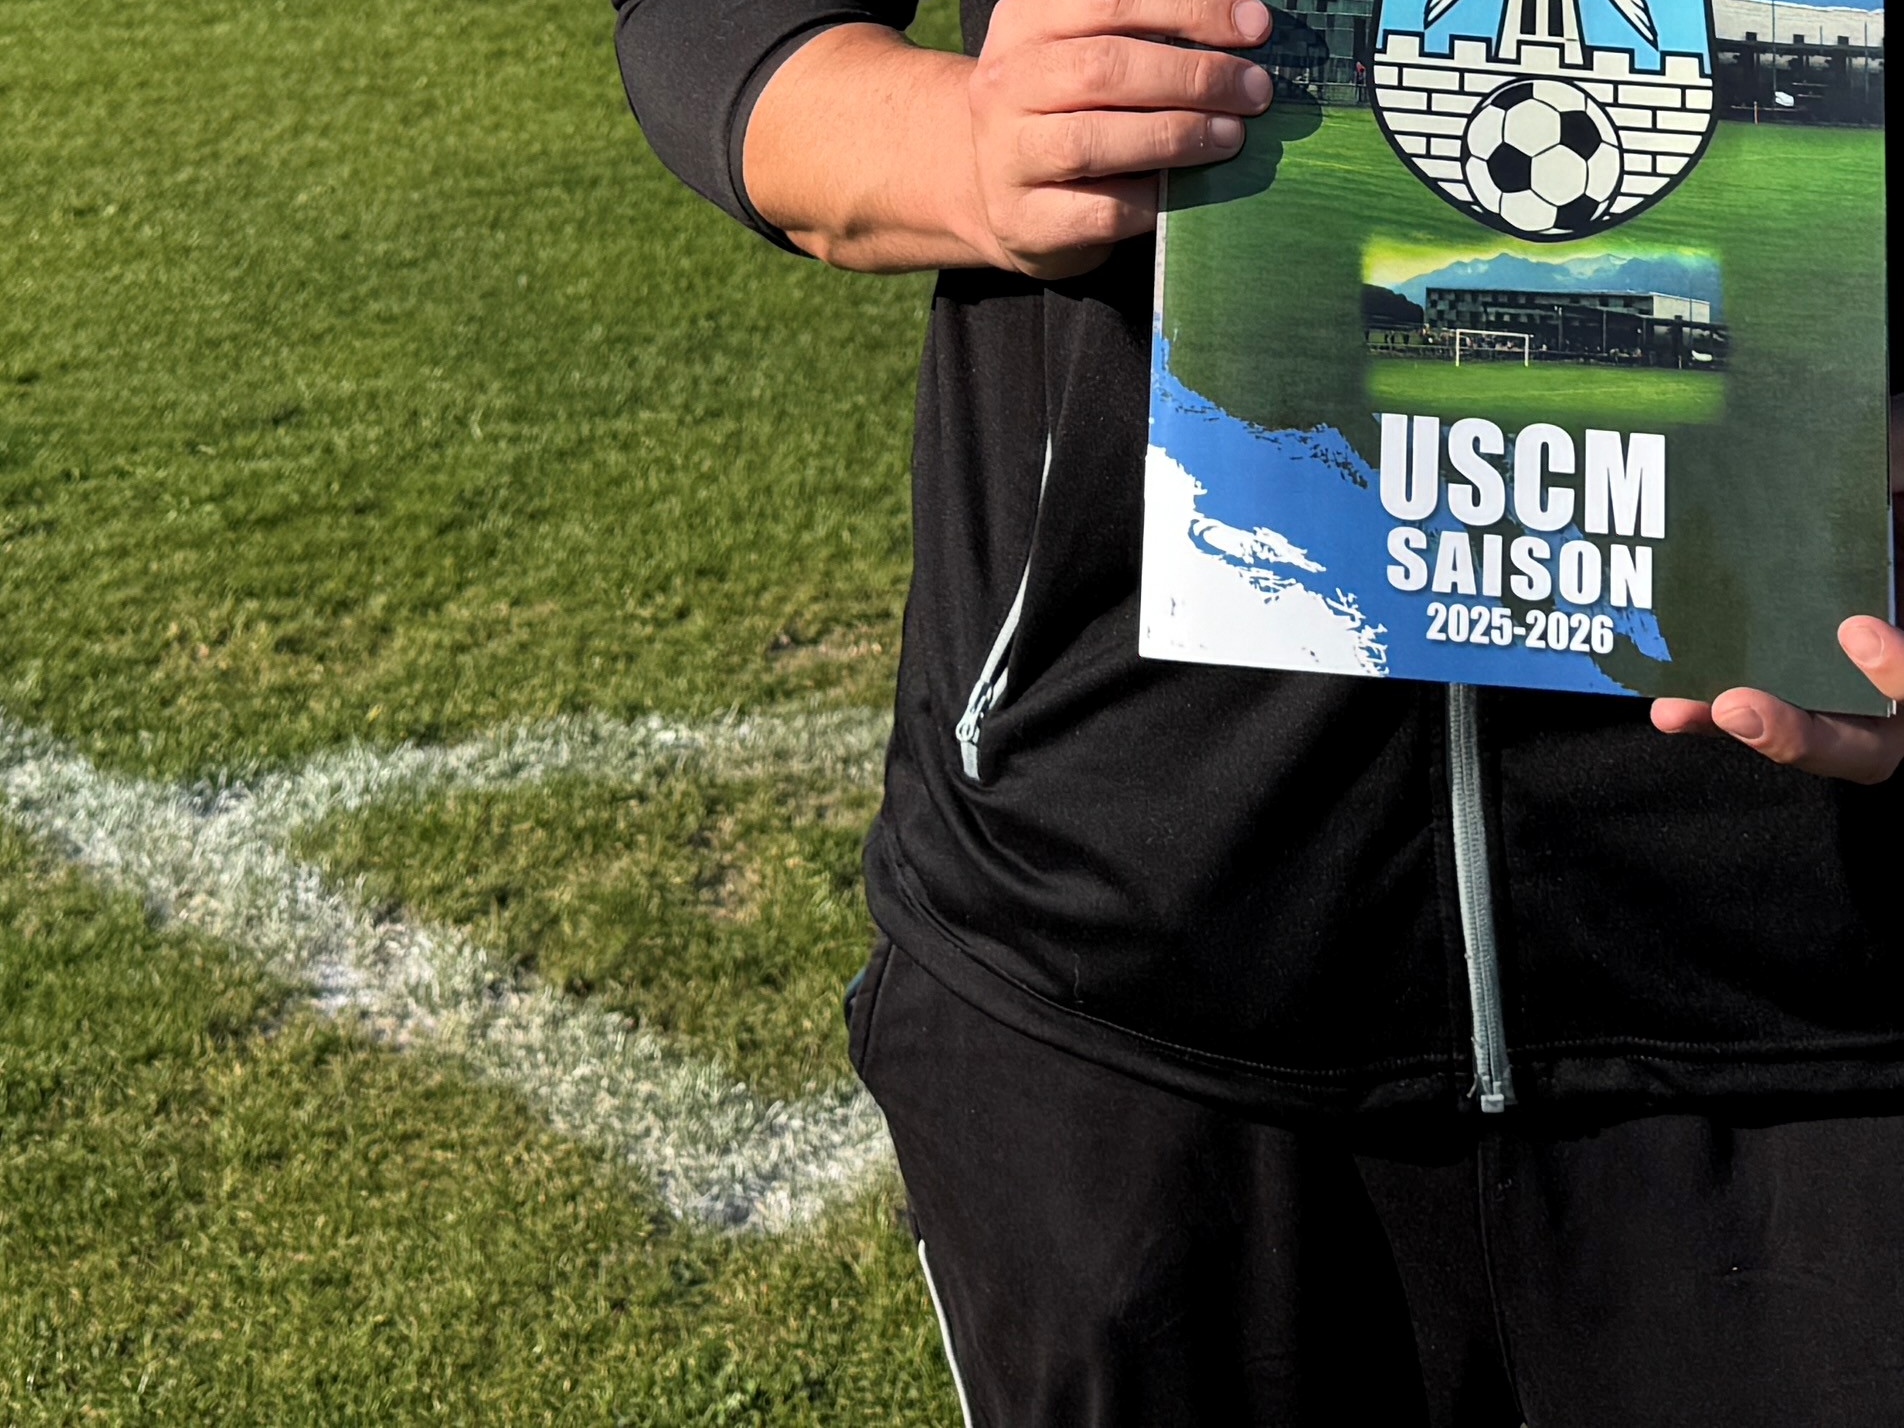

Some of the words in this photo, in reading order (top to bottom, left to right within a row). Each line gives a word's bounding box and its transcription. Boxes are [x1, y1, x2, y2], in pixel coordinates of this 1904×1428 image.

[1379, 412, 1666, 539] USCM
[1386, 526, 1653, 610] SAISON
[1425, 602, 1614, 654] 2025-2026
